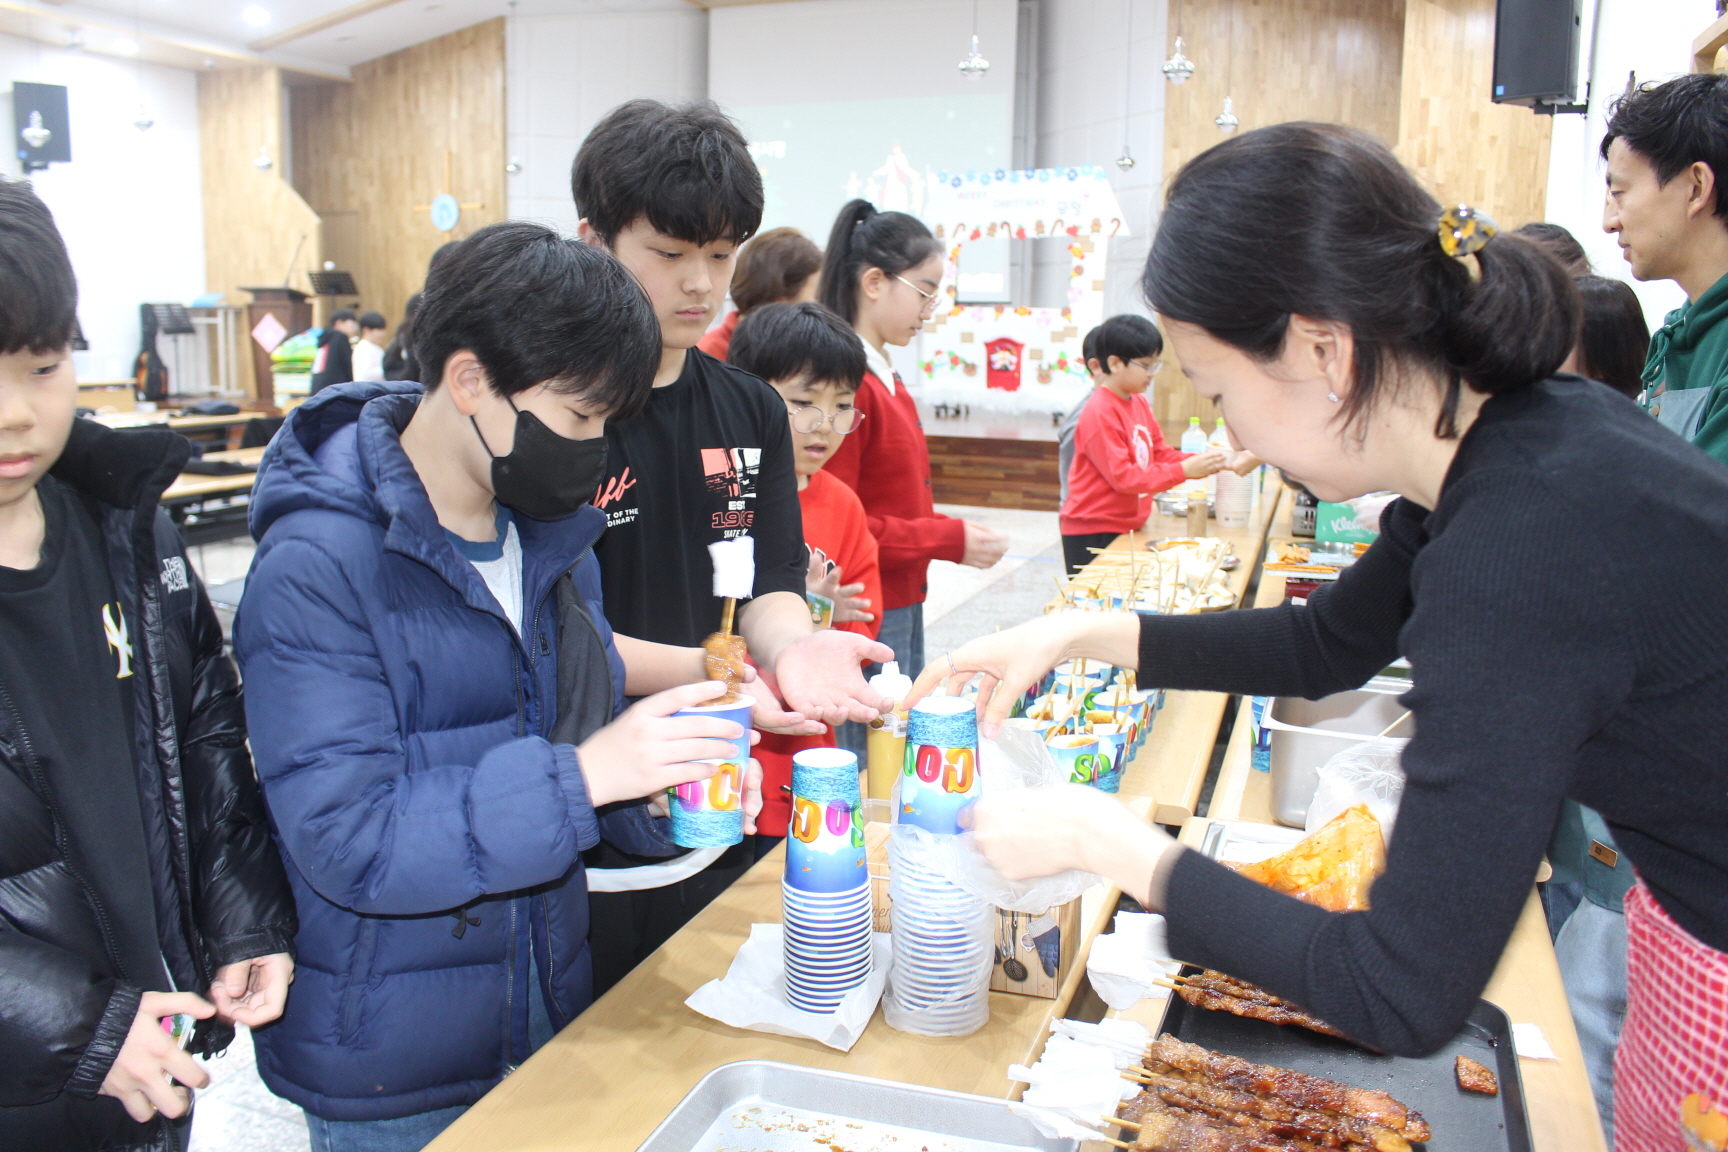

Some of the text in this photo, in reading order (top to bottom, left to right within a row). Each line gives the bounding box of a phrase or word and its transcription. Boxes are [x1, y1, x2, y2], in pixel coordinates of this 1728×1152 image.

[613, 511, 624, 519] OF
[625, 508, 639, 516] THE
[607, 515, 636, 528] DINARY
